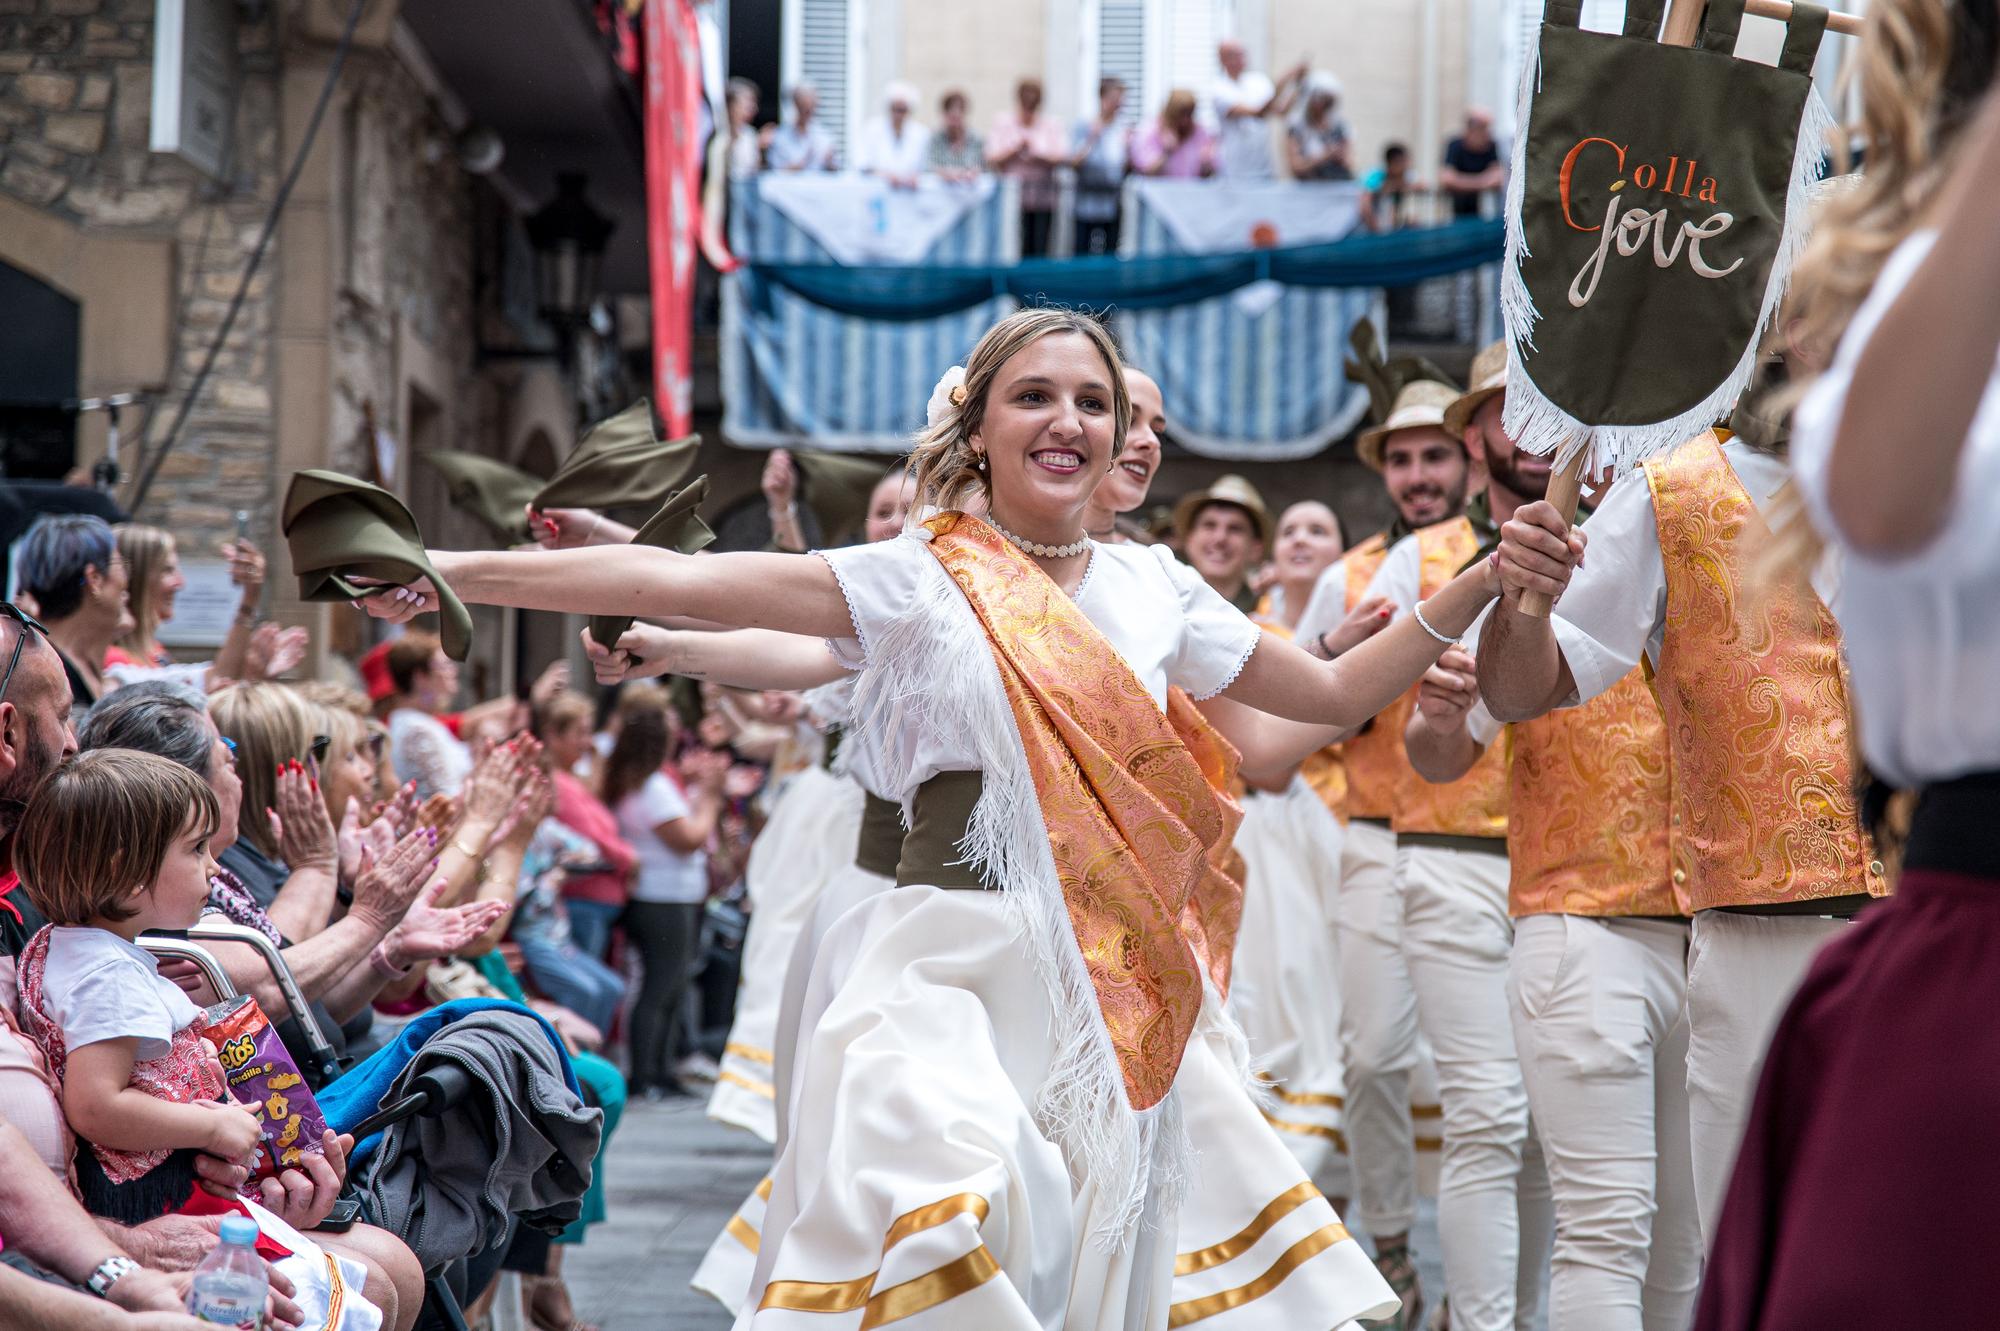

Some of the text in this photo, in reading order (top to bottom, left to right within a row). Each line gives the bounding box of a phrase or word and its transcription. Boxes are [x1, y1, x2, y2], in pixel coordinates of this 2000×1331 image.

[1559, 137, 1719, 232] Colla
[1569, 180, 1744, 308] jove
[218, 1034, 256, 1070] etos
